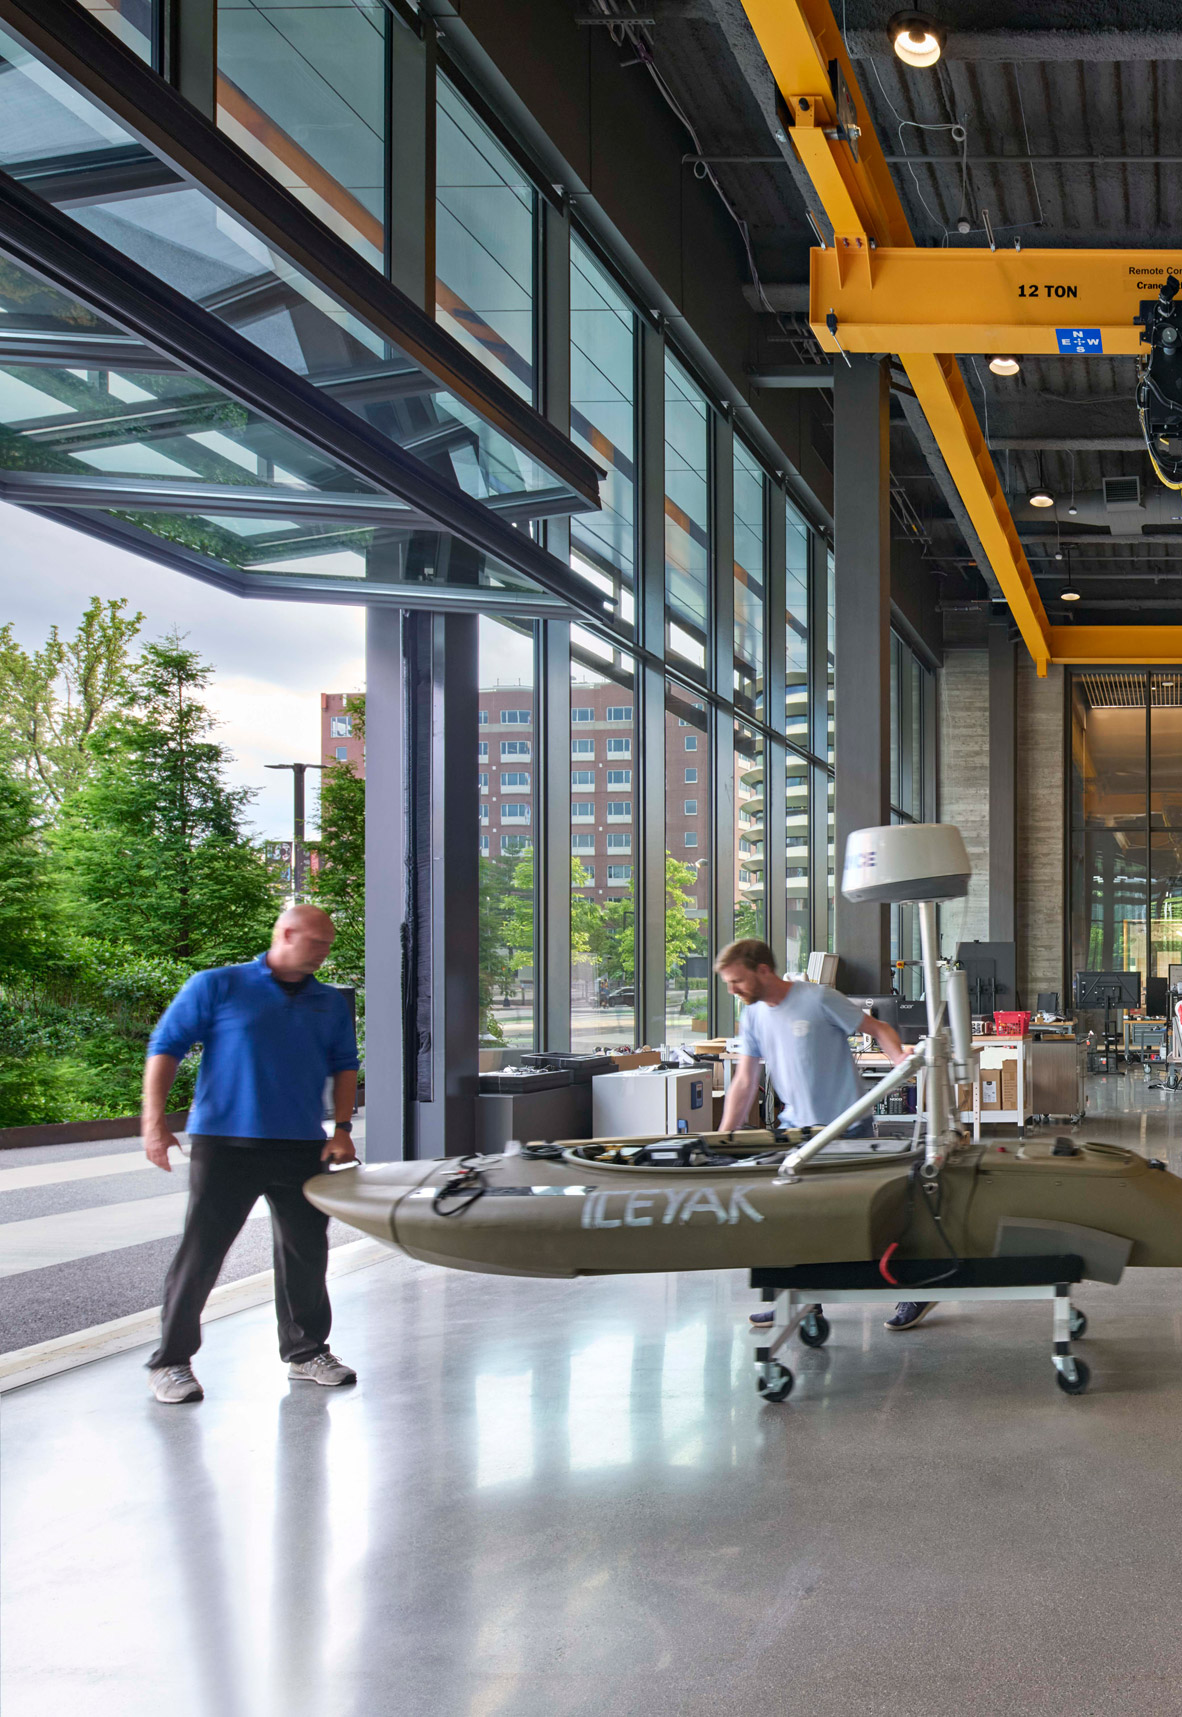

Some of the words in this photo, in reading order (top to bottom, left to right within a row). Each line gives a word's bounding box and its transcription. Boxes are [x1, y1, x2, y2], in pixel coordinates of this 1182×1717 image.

[1129, 267, 1164, 275] Remote
[1018, 285, 1039, 297] 12
[1045, 285, 1078, 298] TON
[581, 1185, 765, 1229] ICEYAK
